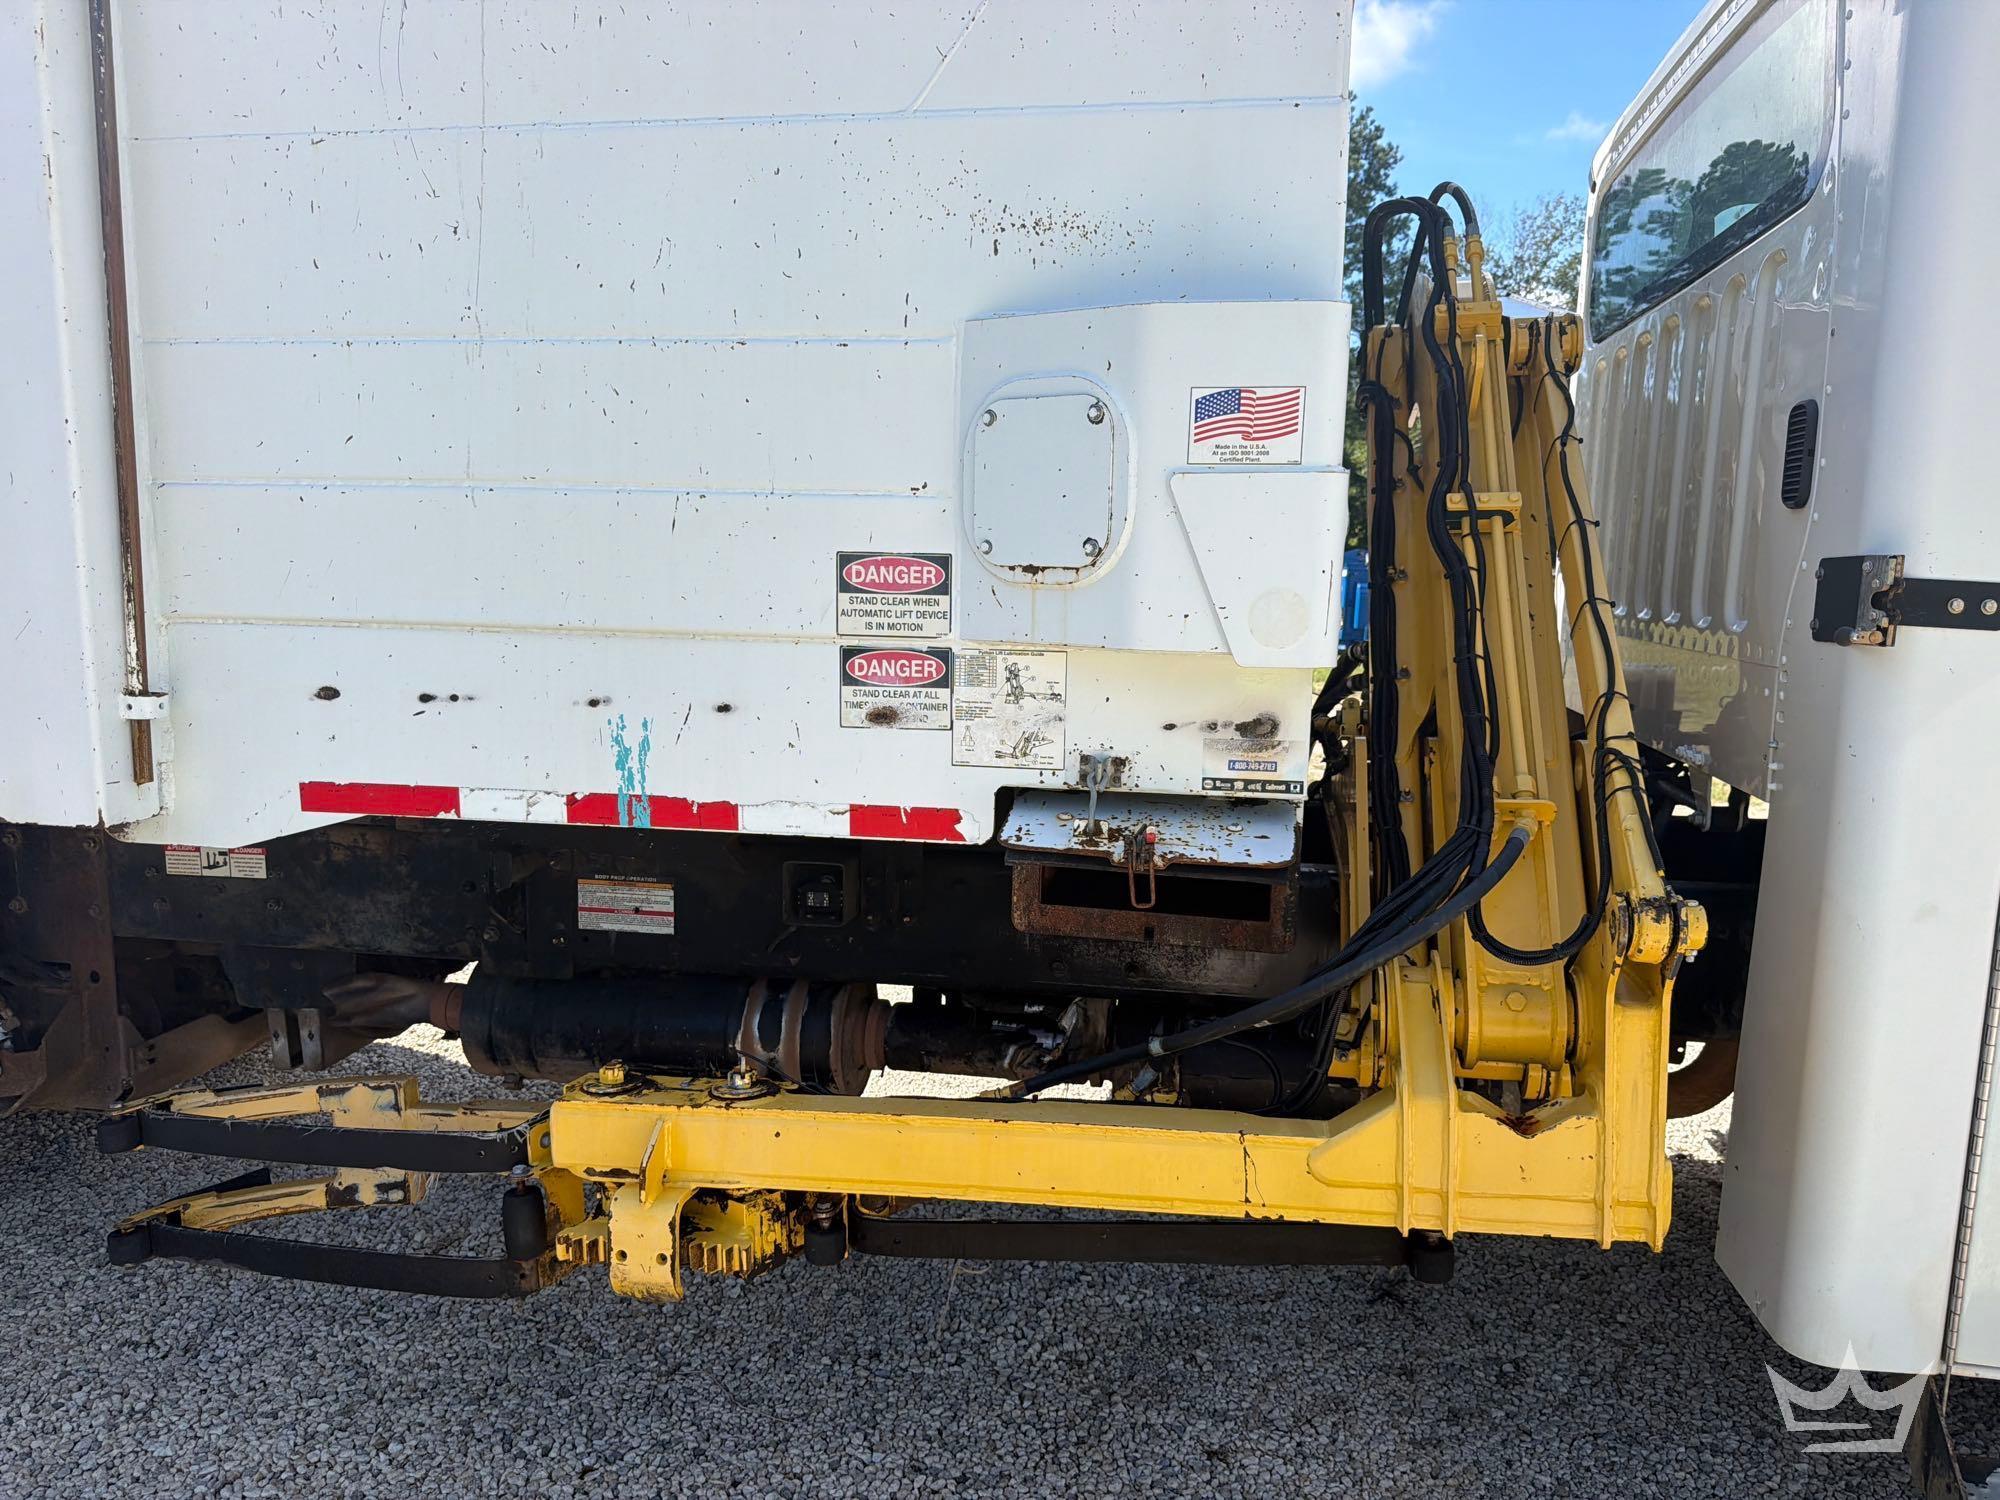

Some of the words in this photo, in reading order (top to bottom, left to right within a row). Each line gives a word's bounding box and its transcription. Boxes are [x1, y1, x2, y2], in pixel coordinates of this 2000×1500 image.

[850, 564, 937, 585] DANGER
[848, 595, 878, 606] STAND
[880, 596, 911, 606] CLEAR
[912, 597, 940, 607] WHEN
[840, 608, 893, 619] AUTOMATIC
[895, 610, 914, 620] LIFT
[915, 610, 949, 620] DEVICE
[865, 621, 874, 631] IS
[875, 622, 885, 631] IN
[887, 622, 924, 632] MOTION
[854, 658, 938, 678] DANGER
[852, 688, 880, 698] STAND
[881, 689, 911, 699] CLEAR
[912, 690, 923, 699] AT
[924, 690, 941, 700] ALL
